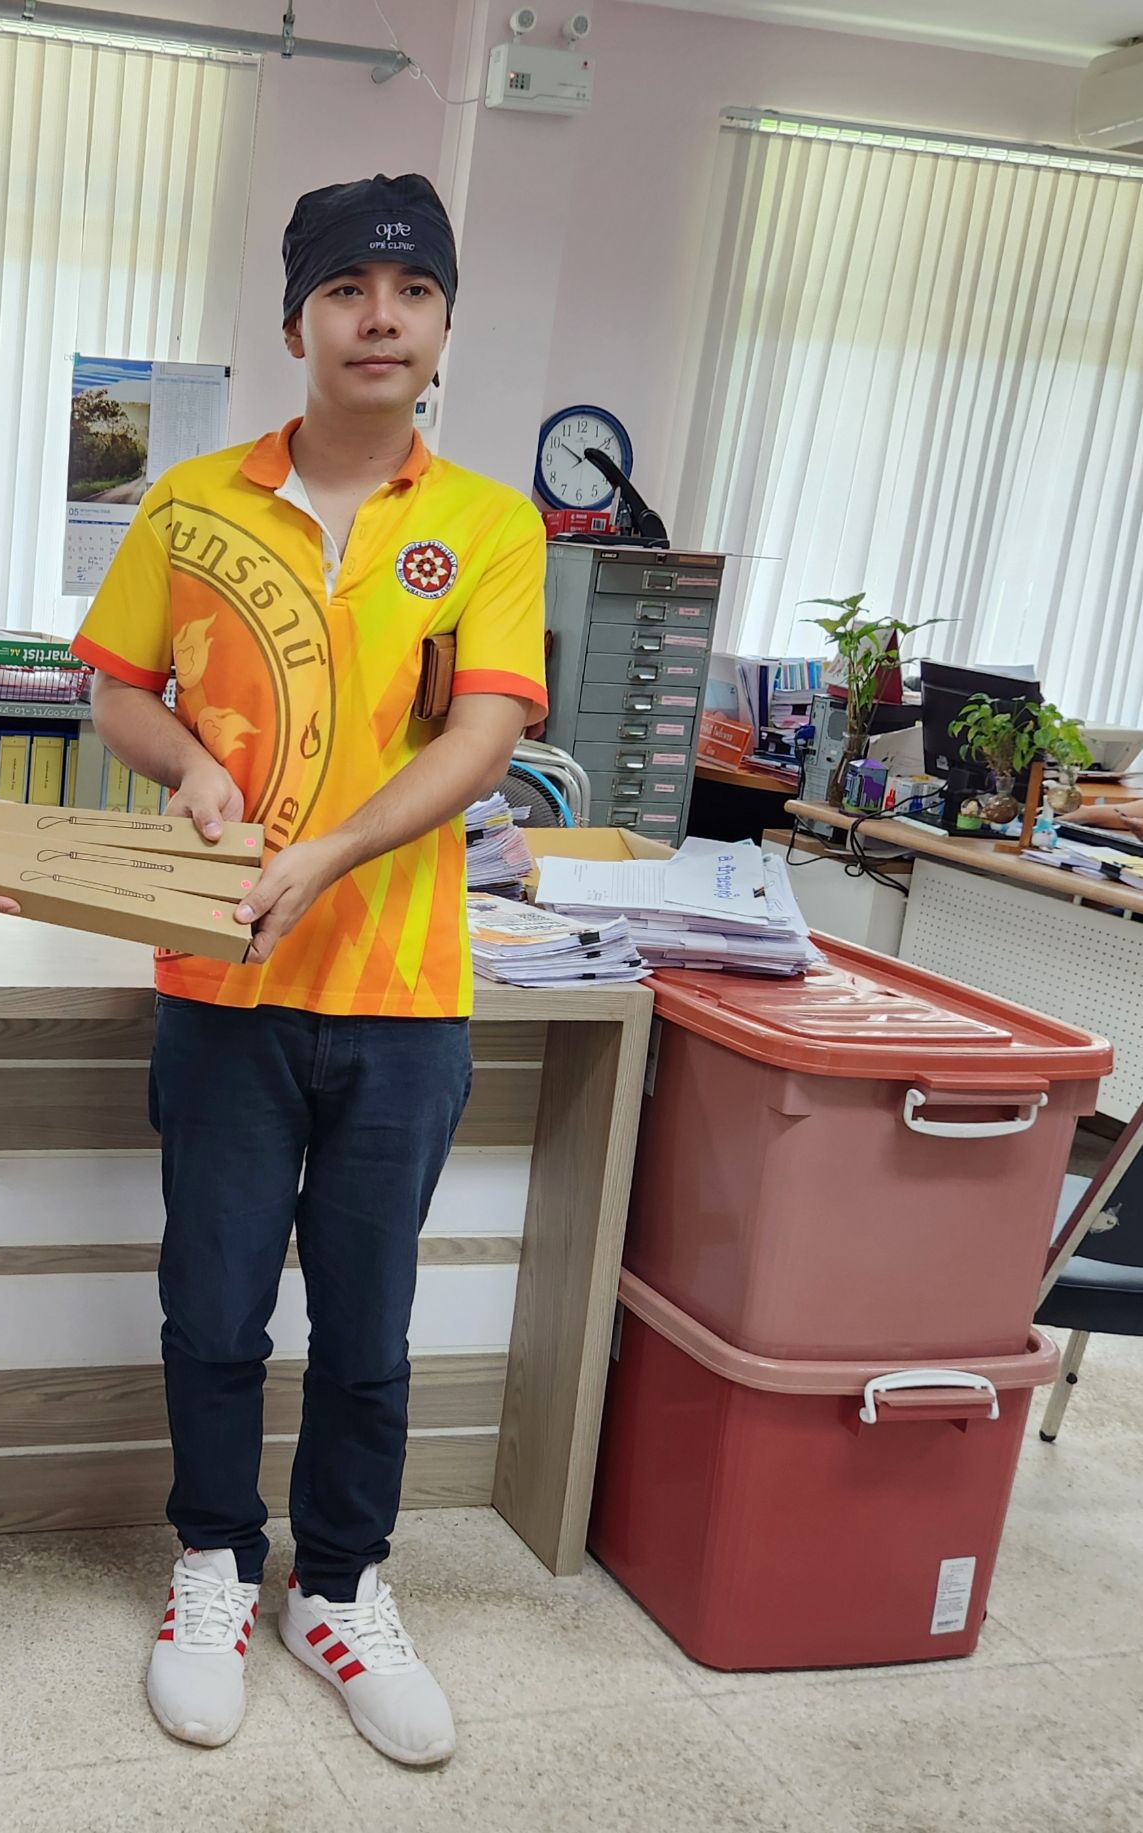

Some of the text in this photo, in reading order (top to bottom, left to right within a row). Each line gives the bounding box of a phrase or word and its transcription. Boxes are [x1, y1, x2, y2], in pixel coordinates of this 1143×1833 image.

[387, 241, 415, 251] CLINIC
[562, 424, 571, 437] 11
[576, 420, 588, 433] 12
[550, 437, 561, 449] 10
[68, 507, 79, 516] 05
[10, 648, 21, 656] A4
